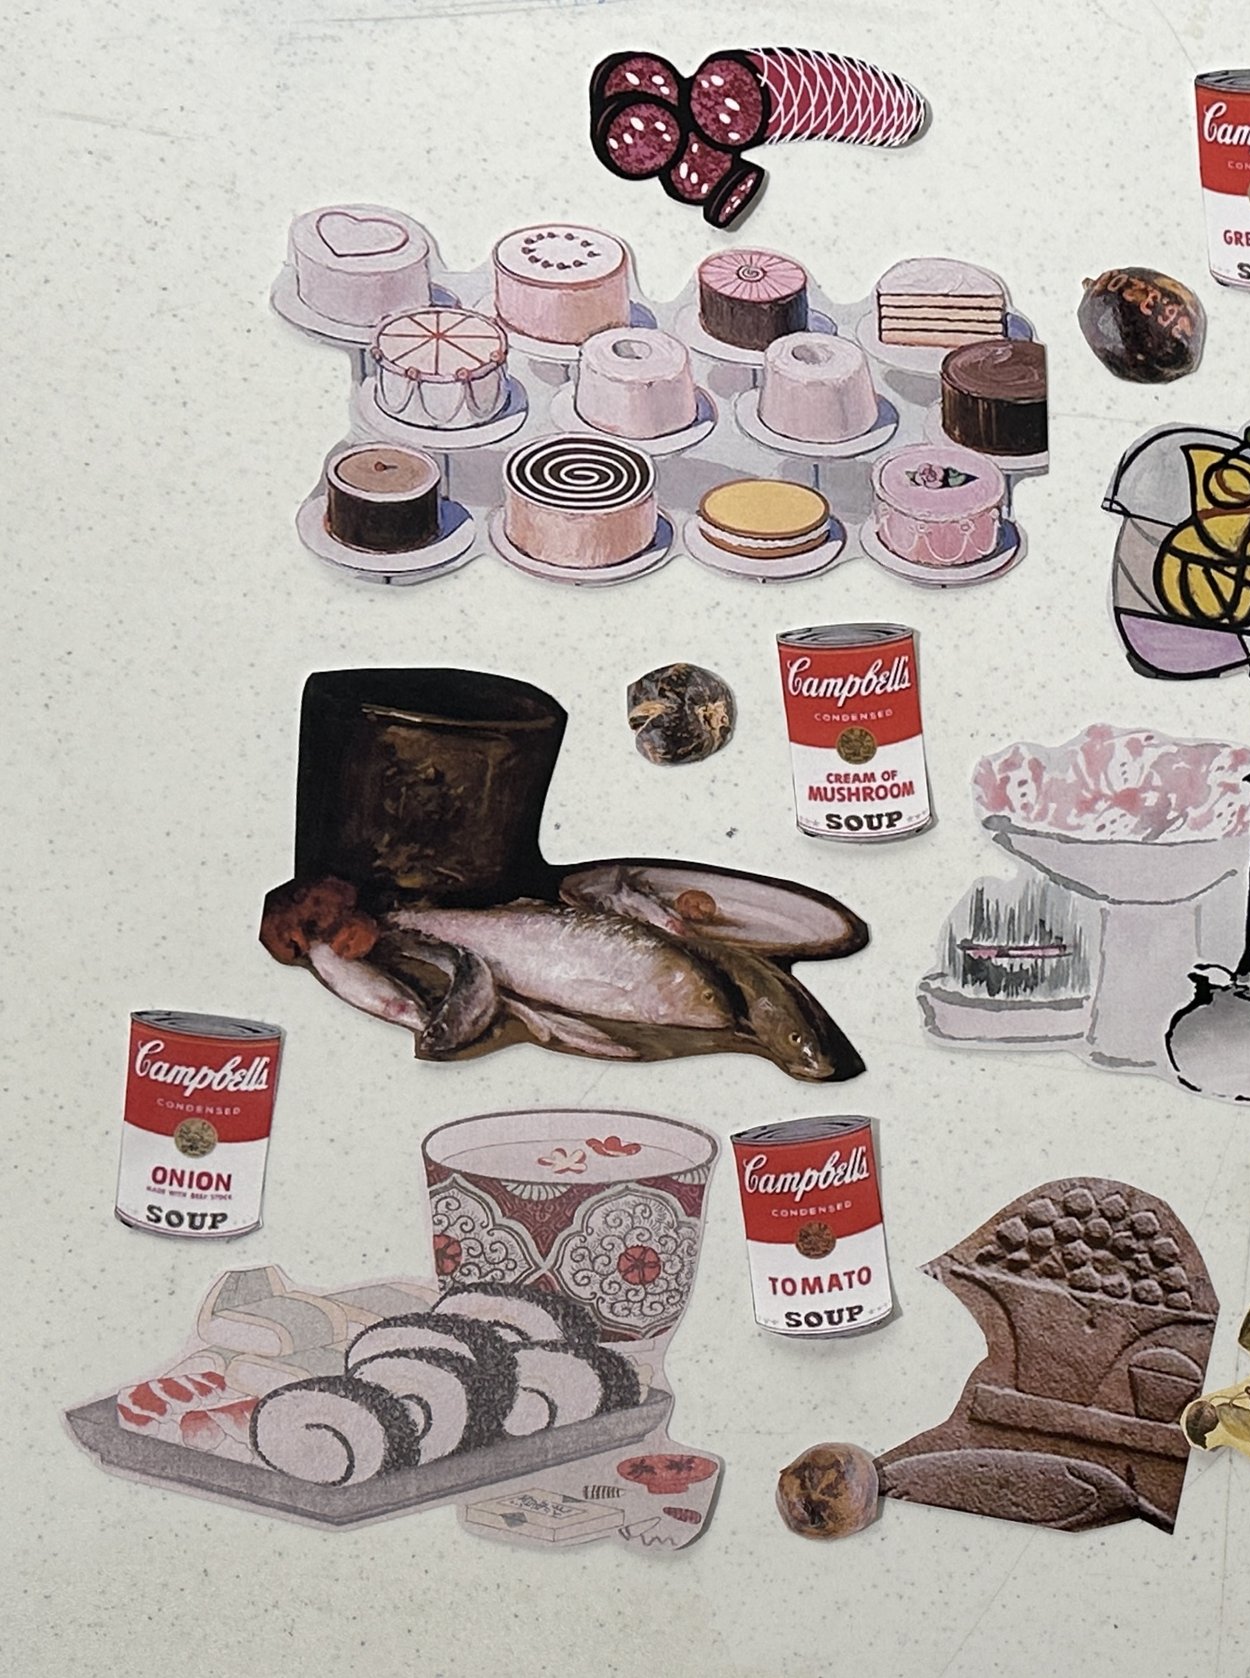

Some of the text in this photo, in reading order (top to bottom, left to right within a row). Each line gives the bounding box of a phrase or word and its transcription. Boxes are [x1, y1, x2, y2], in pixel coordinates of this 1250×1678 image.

[814, 708, 893, 722] CONDENSED
[826, 770, 898, 784] CREAM OF
[808, 781, 915, 802] MUSHROOM
[825, 811, 903, 831] SOUP
[156, 1098, 241, 1115] CONDENSED
[152, 1166, 232, 1192] ONION
[146, 1204, 228, 1230] SOUP
[771, 1201, 852, 1217] CONDENSED
[768, 1266, 872, 1295] TOMATO
[785, 1305, 863, 1328] SOUP
